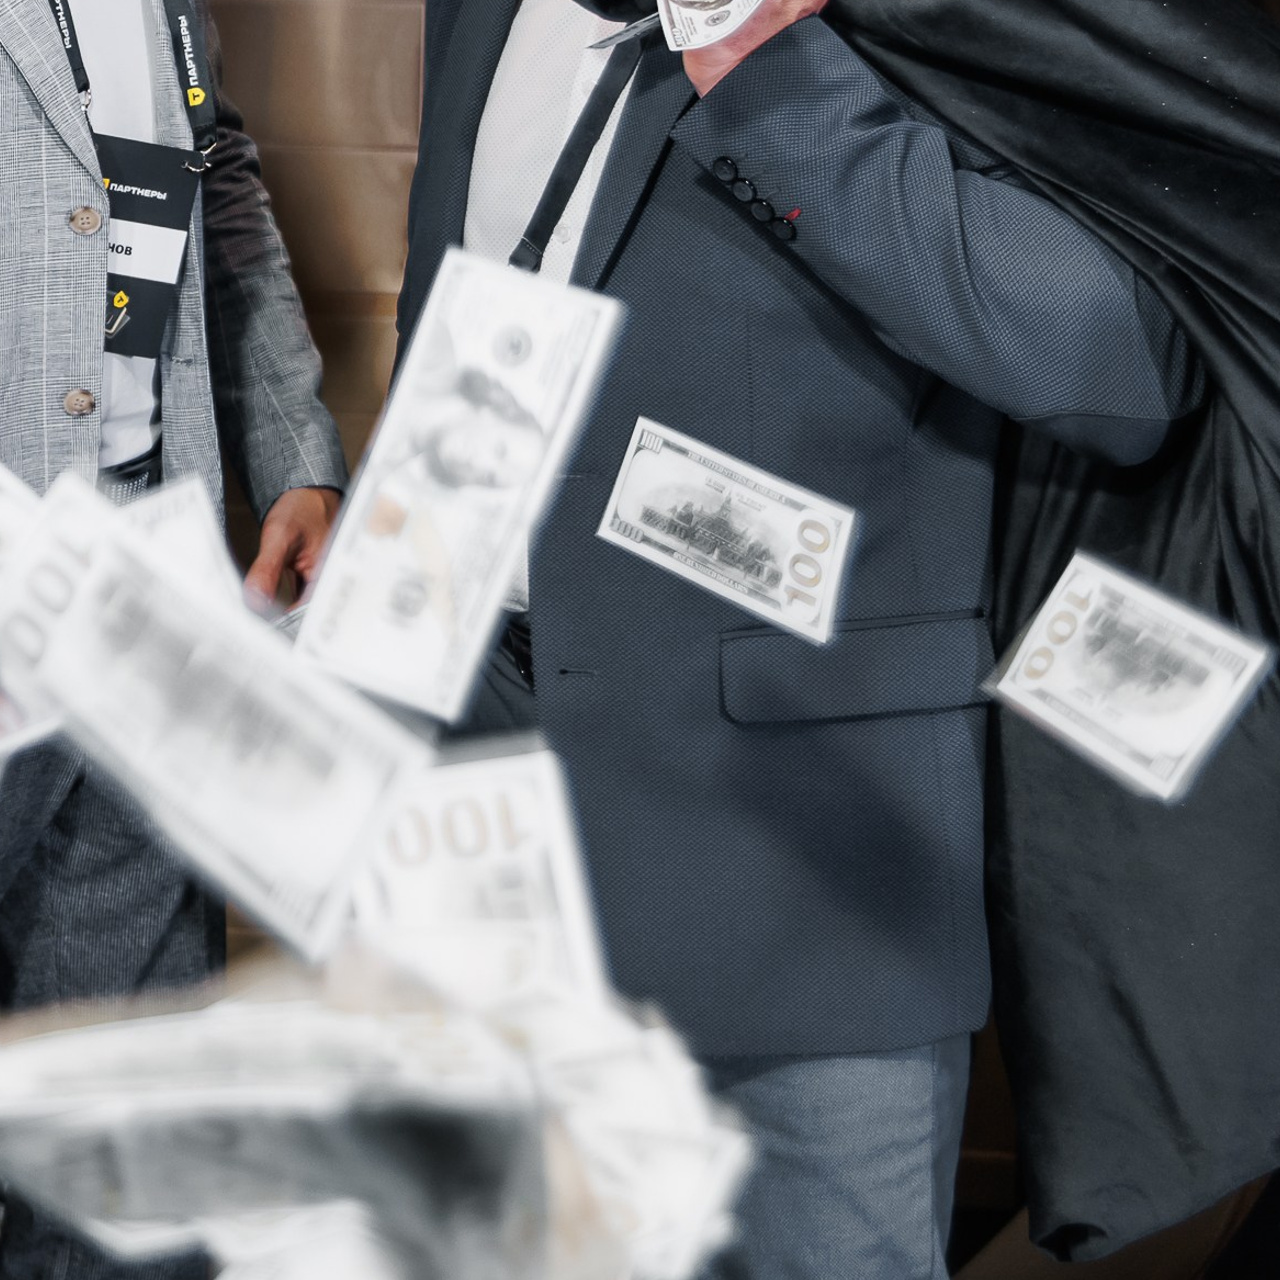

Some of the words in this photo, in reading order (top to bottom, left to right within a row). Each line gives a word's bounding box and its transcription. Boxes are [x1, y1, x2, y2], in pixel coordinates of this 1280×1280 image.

[178, 15, 199, 86] ПАРТНЕРЫ
[109, 182, 168, 200] ПАРТНЕРЫ
[783, 519, 831, 607] 100
[1024, 588, 1093, 680] 100
